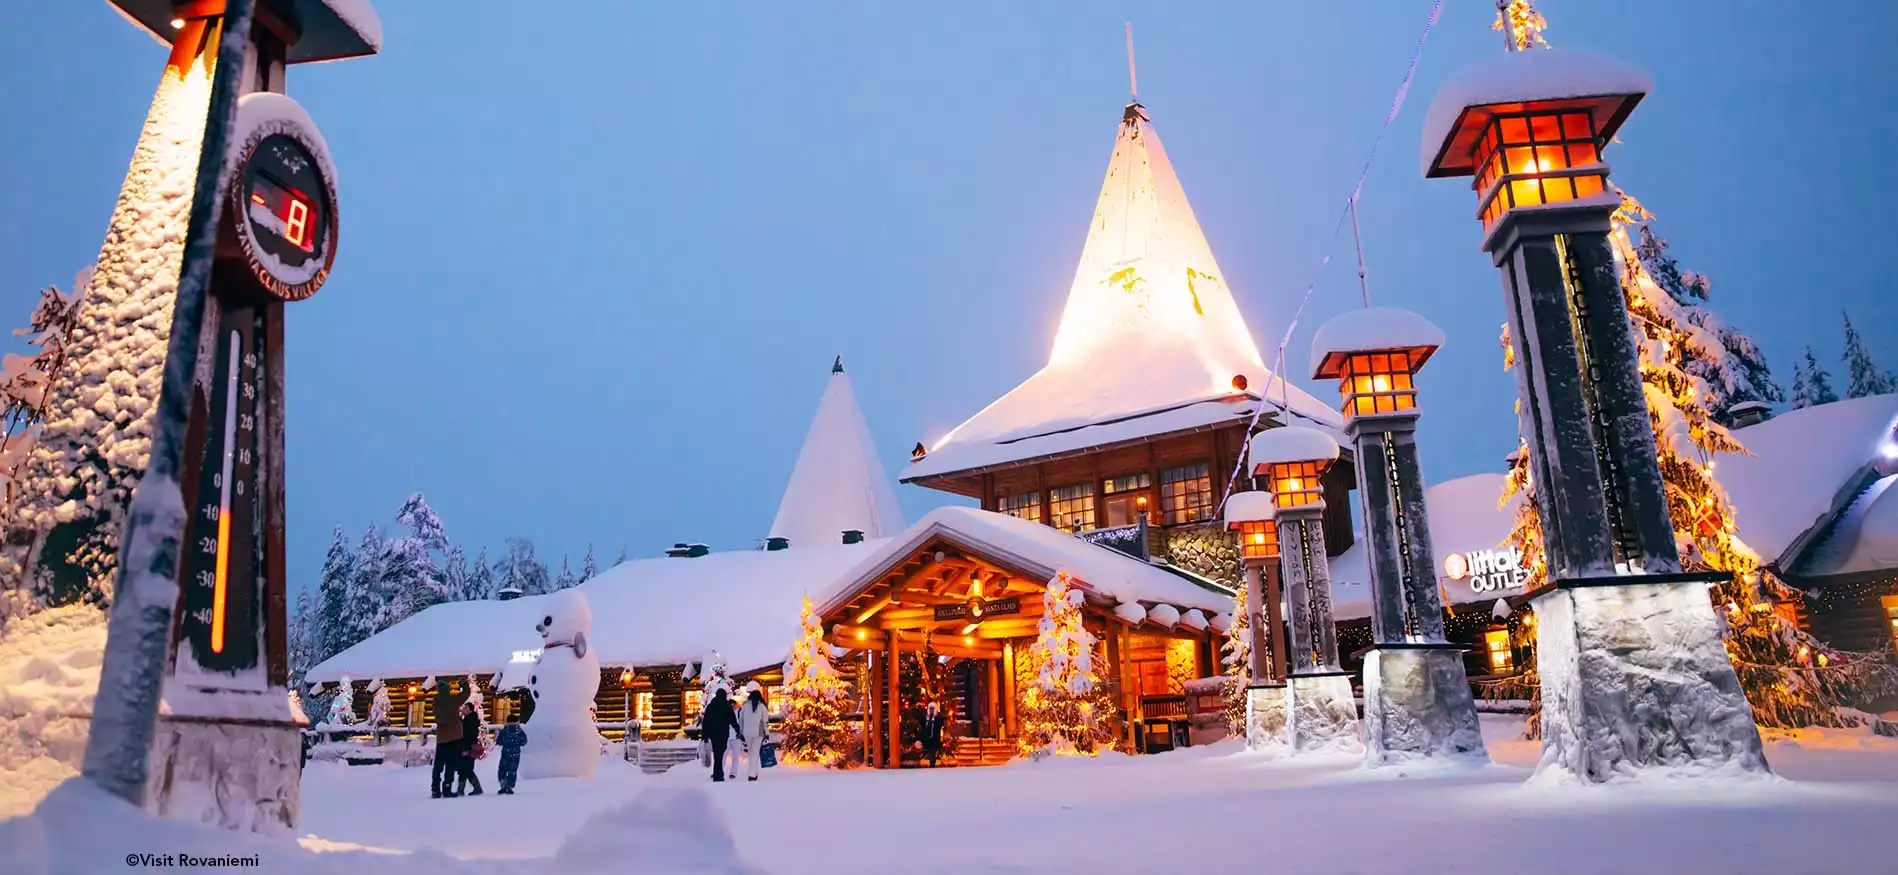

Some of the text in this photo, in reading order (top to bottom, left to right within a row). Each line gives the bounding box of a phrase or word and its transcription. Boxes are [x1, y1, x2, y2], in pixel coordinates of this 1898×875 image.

[236, 223, 259, 274] SANTA
[260, 269, 291, 299] CLAUS
[244, 352, 257, 369] 40
[242, 382, 255, 400] 30
[240, 414, 253, 431] 20
[239, 448, 251, 464] 10
[214, 472, 221, 488] 0
[236, 479, 244, 495] 0
[202, 503, 219, 521] -10
[199, 536, 217, 553] -20
[196, 569, 215, 588] -30
[192, 607, 212, 625] -40
